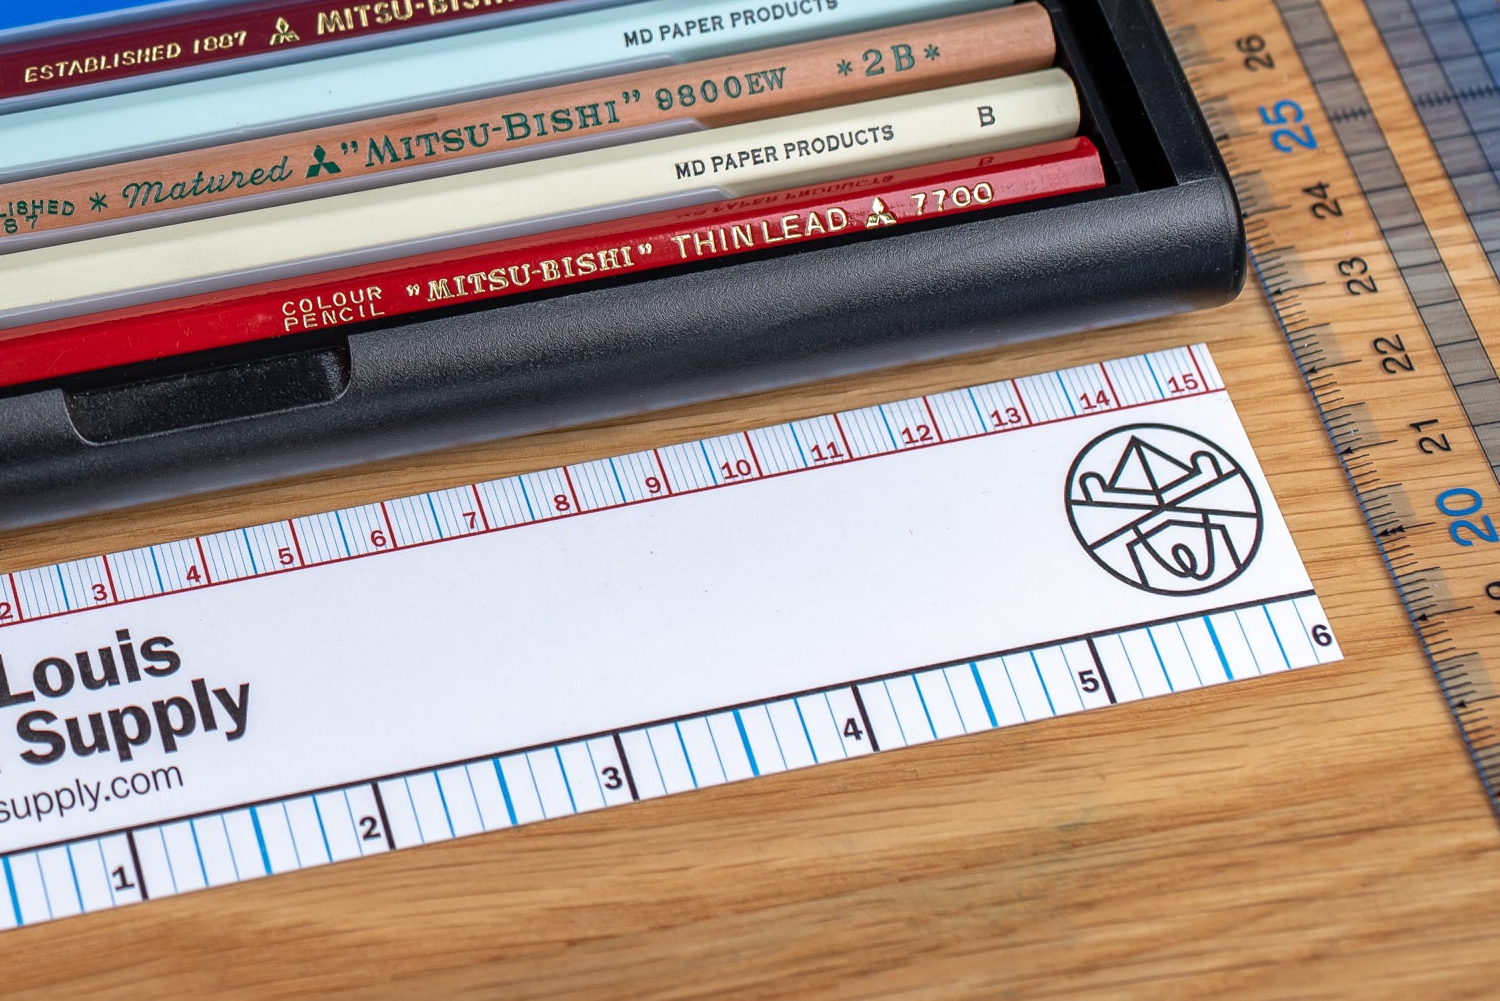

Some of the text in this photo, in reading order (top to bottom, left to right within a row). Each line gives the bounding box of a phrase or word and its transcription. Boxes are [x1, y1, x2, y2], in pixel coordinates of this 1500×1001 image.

[624, 28, 653, 47] MD
[659, 15, 725, 42] PAPER
[24, 42, 181, 84] ESTABLISHED
[193, 30, 248, 55] 1887
[1236, 33, 1275, 72] 26
[977, 106, 996, 127] B
[1259, 99, 1317, 153] 25
[122, 157, 294, 210] Matured
[655, 66, 787, 111] 9800EW
[674, 124, 895, 180] MD PAPER PRODUCTS
[910, 181, 995, 215] 7700
[1310, 181, 1343, 220] 24
[1337, 256, 1379, 296] 23
[281, 285, 384, 317] COLOUR
[283, 302, 386, 332] PENCIL
[1373, 332, 1417, 375] 22
[1409, 418, 1452, 455] 21
[91, 583, 107, 602] 3
[185, 565, 202, 584] 4
[278, 547, 295, 566] 5
[370, 529, 387, 548] 6
[463, 511, 477, 530] 7
[553, 493, 572, 512] 8
[644, 475, 661, 495] 9
[721, 458, 752, 480] 10
[811, 440, 844, 462] 11
[901, 423, 934, 447] 12
[990, 407, 1022, 429] 13
[1079, 390, 1112, 412] 14
[1166, 373, 1198, 395] 15
[1436, 487, 1500, 547] 20
[19, 677, 251, 764] Supply
[111, 622, 1333, 893] 1 2 3 4 5 6
